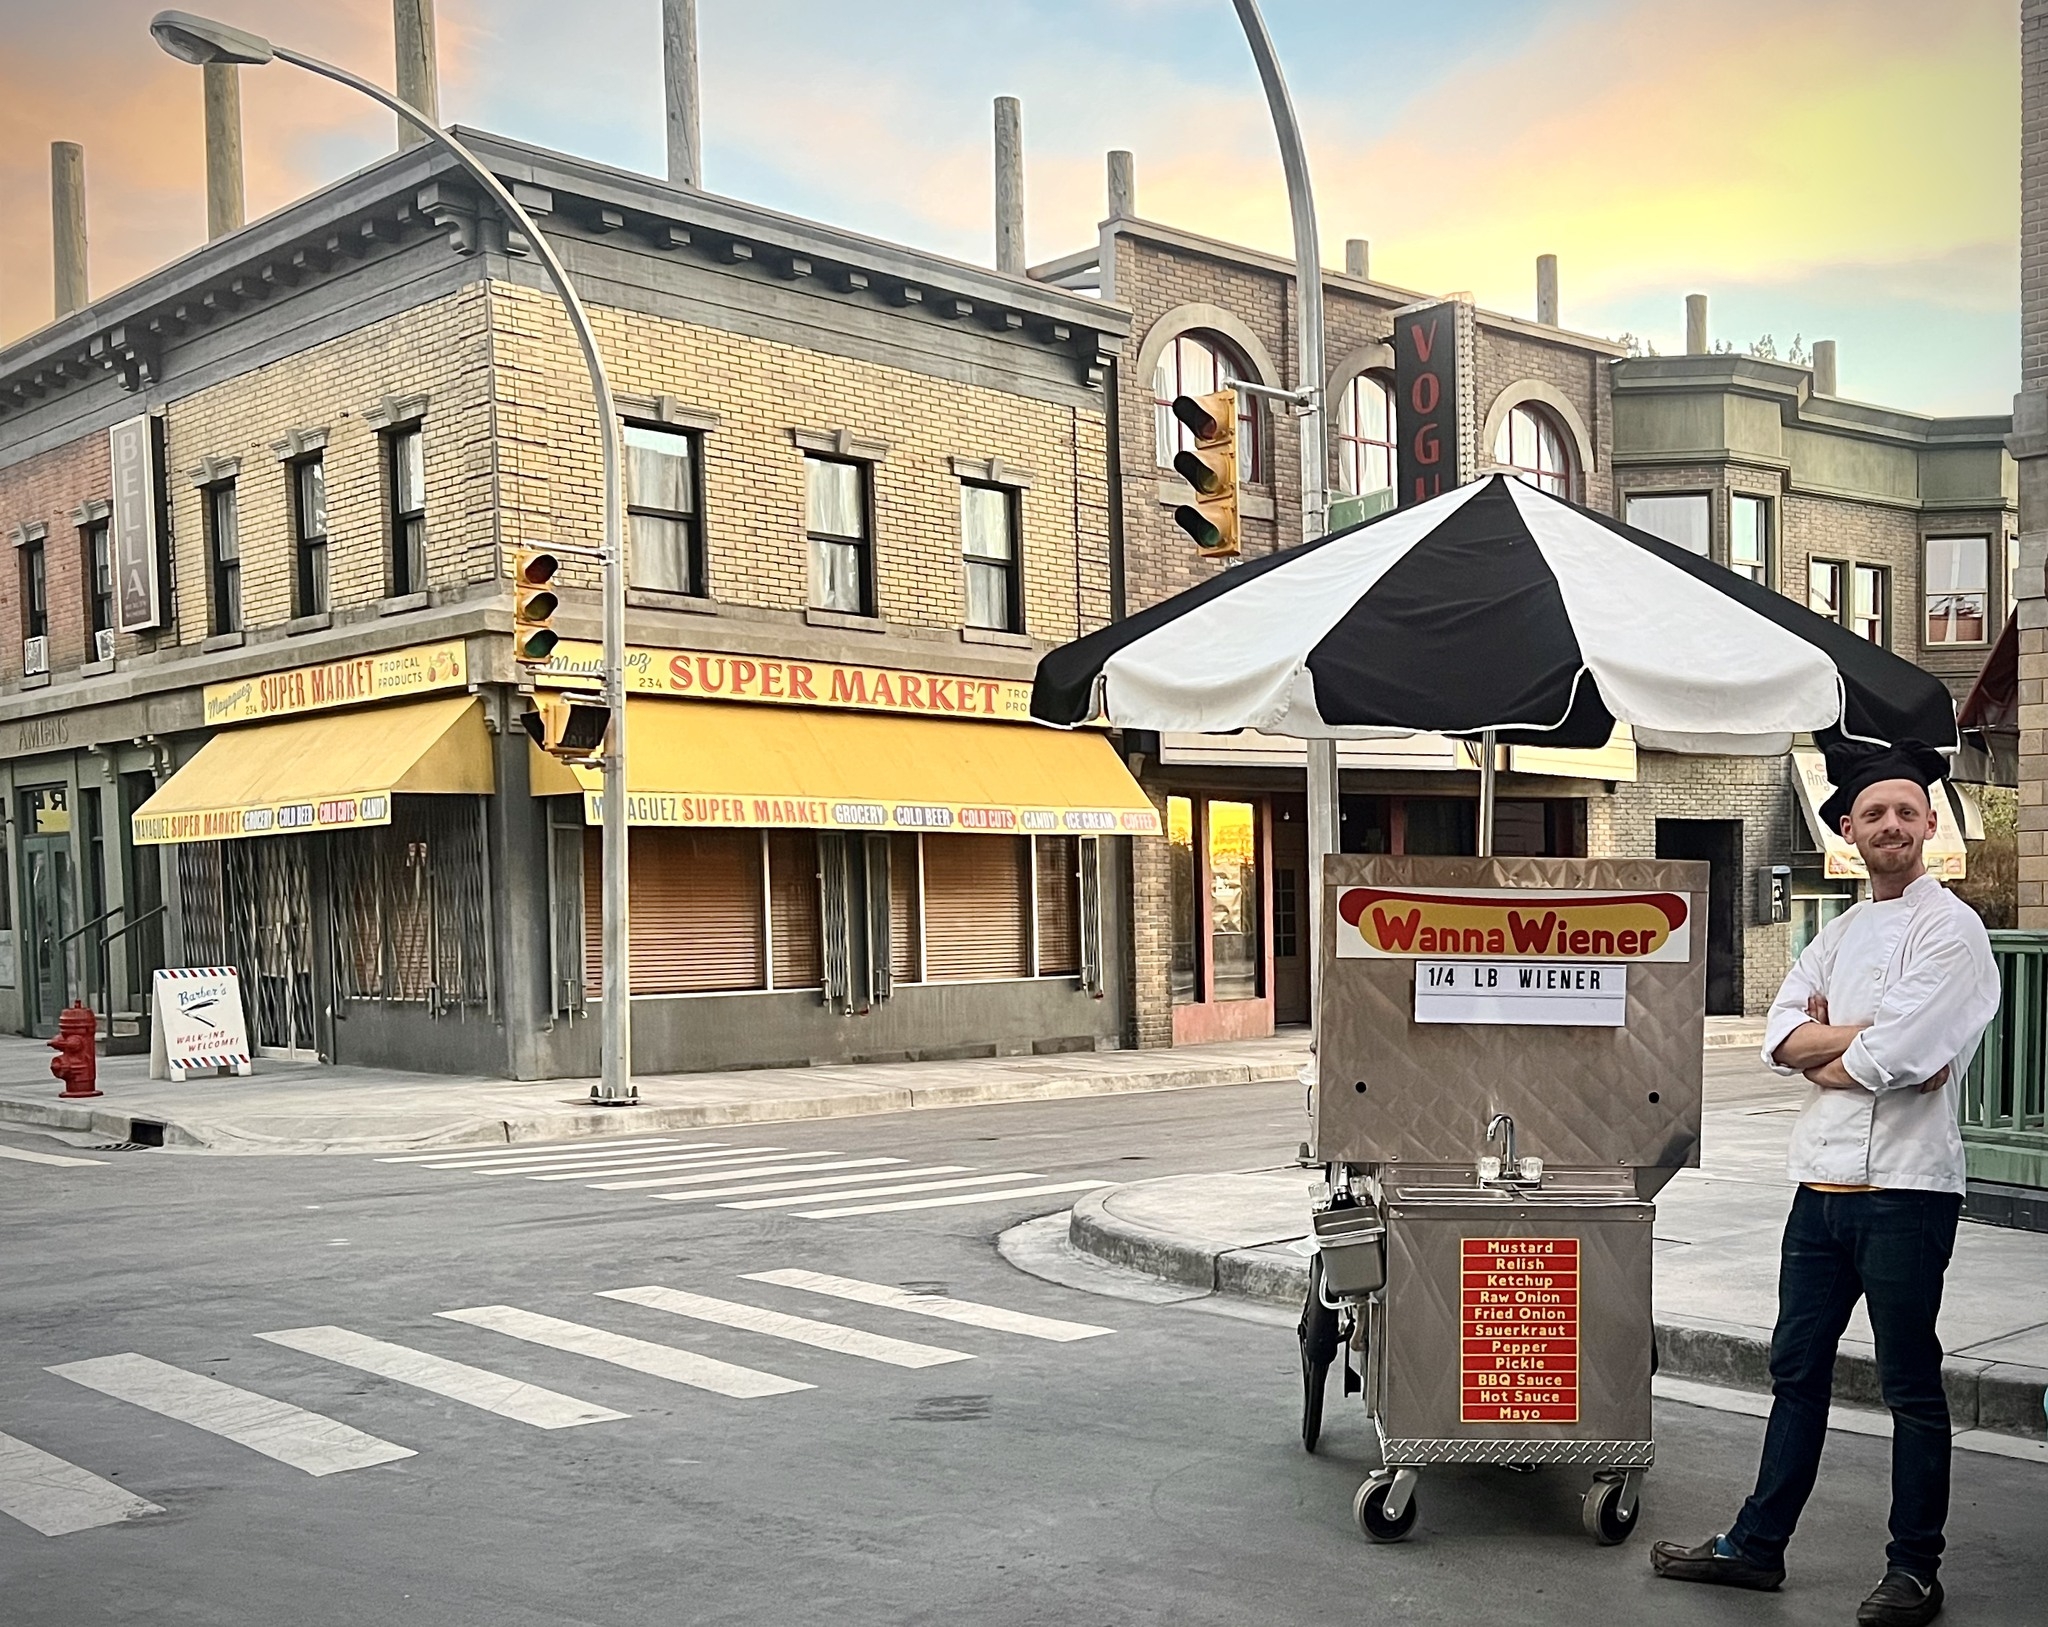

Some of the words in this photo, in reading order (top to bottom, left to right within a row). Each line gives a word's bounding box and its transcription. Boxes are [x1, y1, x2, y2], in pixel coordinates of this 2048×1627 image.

[118, 431, 146, 600] BELLA
[1357, 499, 1366, 523] 3
[379, 656, 421, 674] TROPICAL
[260, 672, 306, 713] SUPER
[311, 660, 374, 705] MARKET
[378, 672, 423, 689] PRODUCTS
[639, 677, 663, 689] 234
[668, 654, 818, 700] SUPER
[830, 668, 999, 715] MARKET
[1007, 688, 1033, 699] TRO
[245, 705, 258, 716] 234
[19, 717, 69, 751] AMIENS
[171, 814, 200, 838] SUPER
[204, 811, 241, 836] MARKET
[320, 803, 336, 824] COLD
[361, 797, 386, 819] CANDY
[682, 797, 746, 823] SUPER
[754, 799, 829, 825] MARKET
[835, 804, 884, 825] GROCERY
[896, 806, 922, 826] COLD
[924, 807, 950, 827] BEER
[961, 808, 987, 828] COLD
[988, 809, 1014, 829] CUTS
[1023, 811, 1056, 830] CANDY
[1065, 812, 1081, 830] ICE
[1082, 812, 1115, 831] CREAM
[1124, 813, 1153, 830] COFFEE
[1428, 967, 1455, 987] 1/4
[1474, 968, 1498, 988] LB
[1519, 969, 1601, 990] WIENER
[178, 982, 228, 1006] Barber's
[177, 1030, 225, 1045] WALK-INS
[189, 1037, 239, 1052] WELCOME!
[1487, 1241, 1554, 1254] Mustard
[1496, 1258, 1545, 1270] Relish
[1487, 1275, 1553, 1289] Ketchup
[1480, 1291, 1509, 1303] Raw
[1515, 1291, 1560, 1303] Onion
[1474, 1308, 1513, 1320] Fried
[1519, 1308, 1566, 1320] Onion
[1475, 1324, 1565, 1336] Sauerkraut
[1492, 1341, 1548, 1355] Pepper
[1495, 1357, 1545, 1369] Pickle
[1478, 1374, 1511, 1386] BBQ
[1517, 1374, 1562, 1386] Sauce
[1480, 1390, 1509, 1402] Hot
[1514, 1390, 1560, 1402] Sauce
[1500, 1407, 1540, 1420] Mayo
